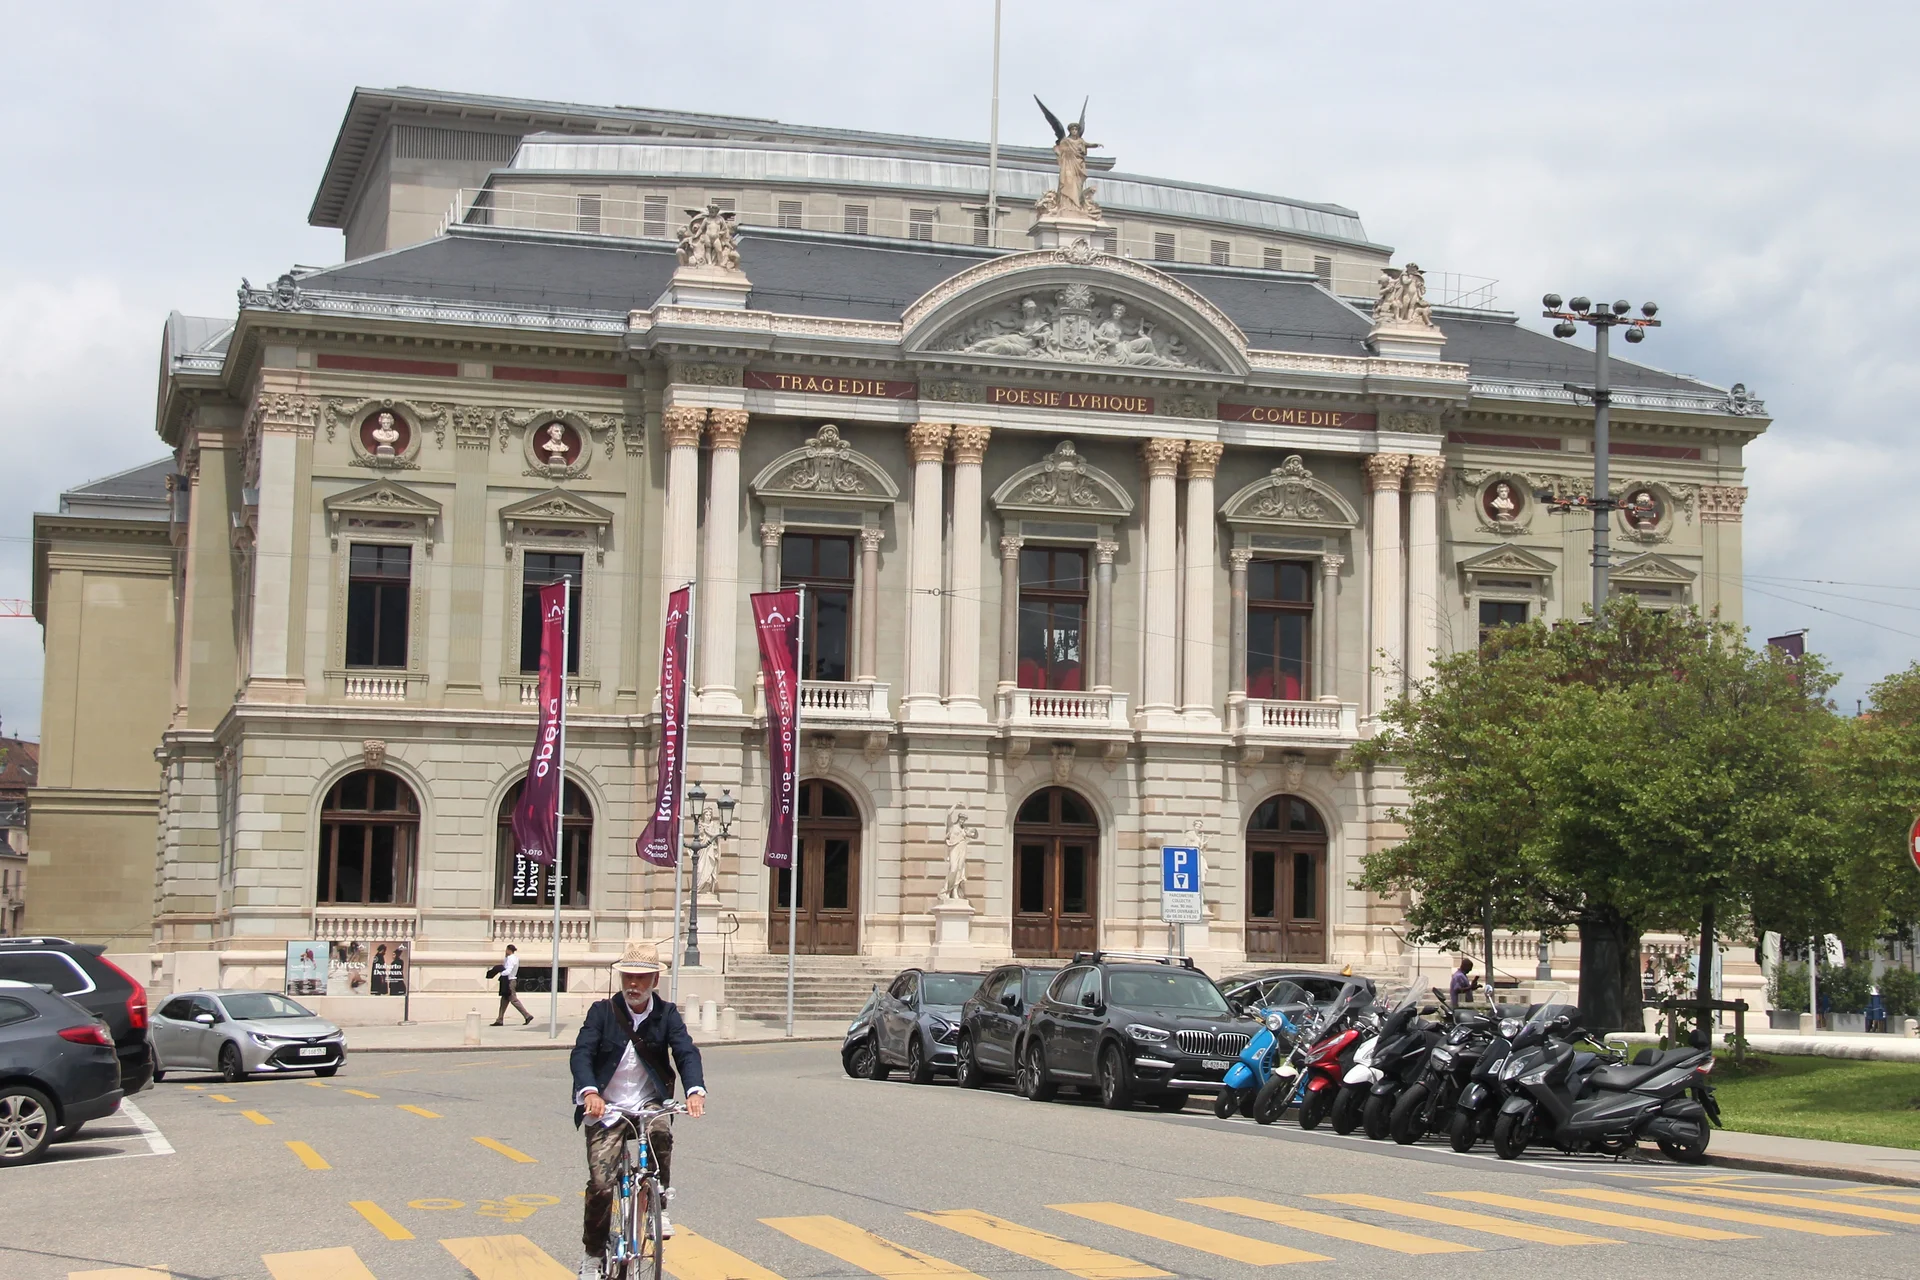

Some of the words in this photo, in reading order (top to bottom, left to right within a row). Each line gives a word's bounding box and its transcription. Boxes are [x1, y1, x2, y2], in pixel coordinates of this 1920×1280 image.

[776, 375, 886, 396] TRAGEDIE
[995, 388, 1060, 406] POESIE
[1069, 393, 1148, 412] LYRIQUE
[1252, 407, 1342, 427] COMEDIE
[1174, 851, 1188, 872] P
[513, 853, 526, 897] Robert
[330, 959, 366, 969] Forces
